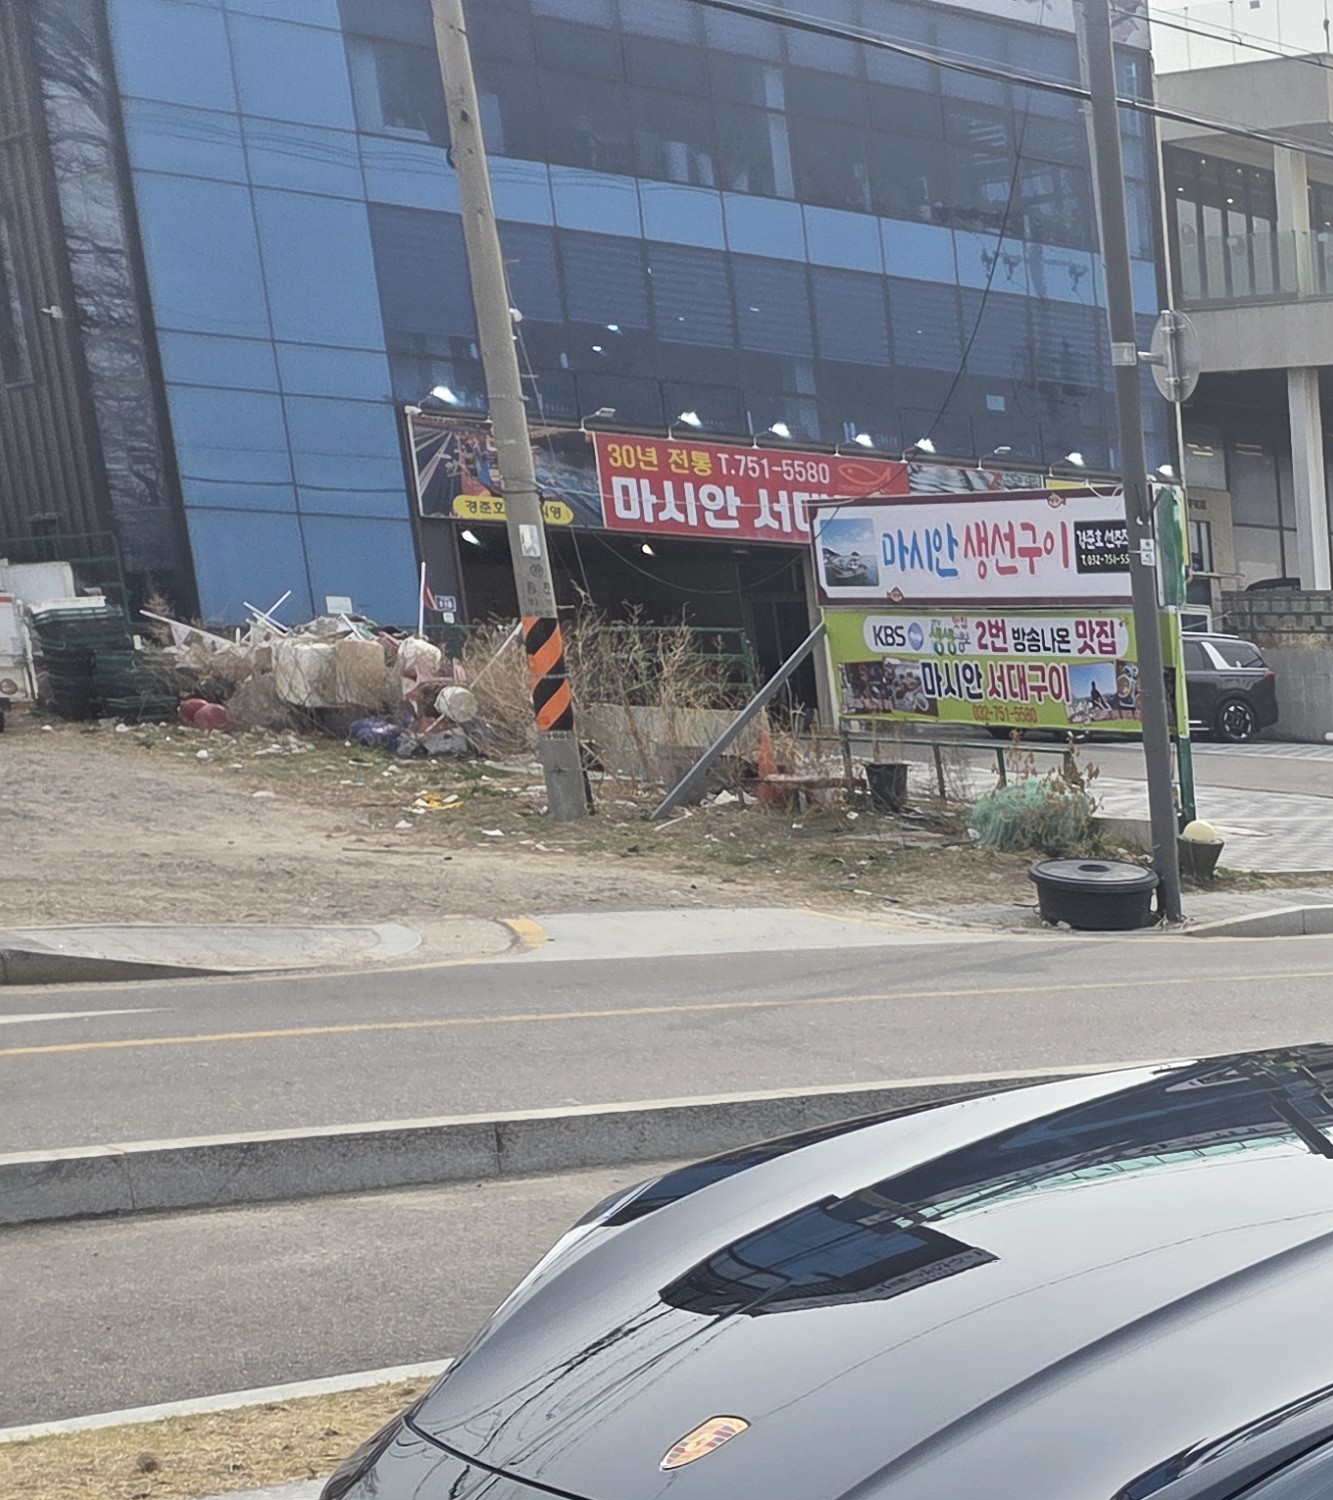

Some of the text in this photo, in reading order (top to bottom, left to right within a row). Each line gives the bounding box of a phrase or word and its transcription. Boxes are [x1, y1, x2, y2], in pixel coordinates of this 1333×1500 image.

[607, 443, 830, 484] 30년 전통 T.751-5580
[611, 476, 741, 529] 마시안
[882, 520, 1070, 580] 마시안 생선구이
[1080, 553, 1130, 566] T.032-751-55
[873, 625, 906, 647] KBS
[975, 619, 1009, 653] 2번
[1011, 626, 1071, 653] 방송나온
[1074, 619, 1117, 655] 맛집
[921, 662, 1071, 703] 마시안 서대구이
[972, 704, 1038, 723] 032-751-5580
